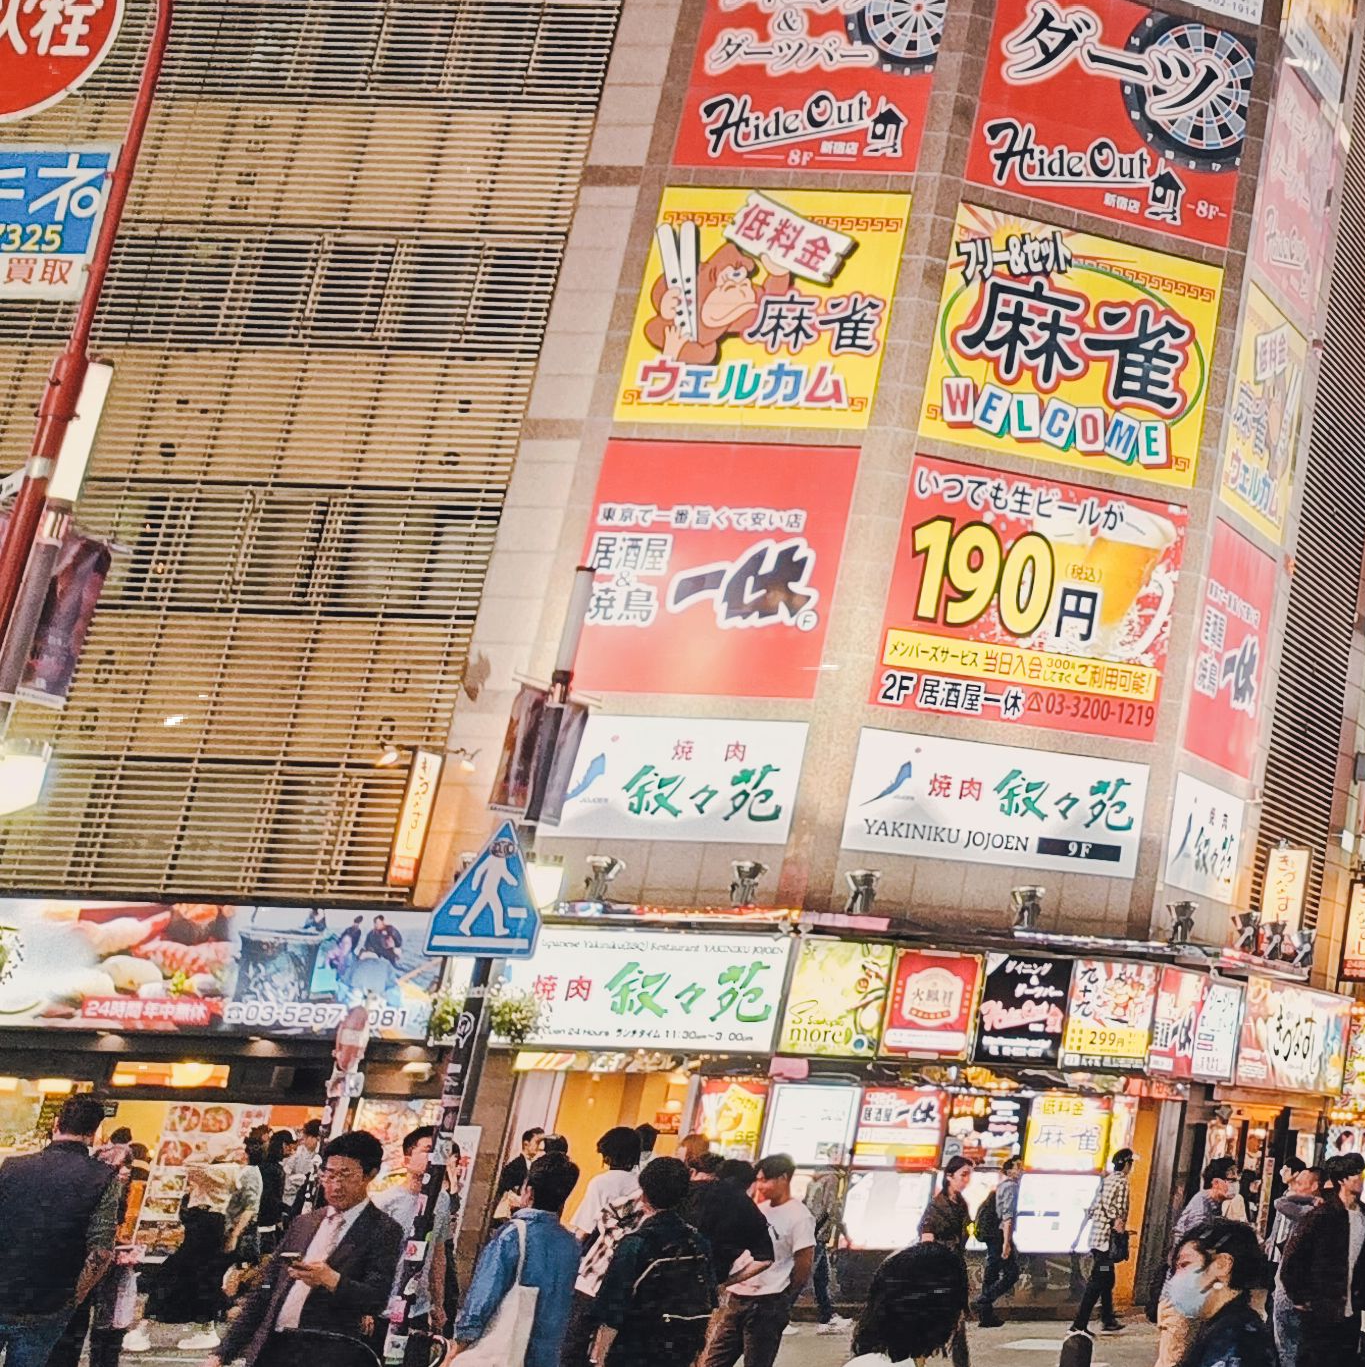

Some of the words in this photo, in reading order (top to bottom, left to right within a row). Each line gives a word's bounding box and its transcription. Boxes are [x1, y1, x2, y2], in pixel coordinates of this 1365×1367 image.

[775, 9, 801, 32] &
[709, 33, 873, 70] ダーツバー
[1006, 1, 1223, 116] ダーツ
[1103, 192, 1141, 213] 新宿店
[735, 203, 832, 272] 低料金
[956, 231, 1073, 287] フリー&セット
[6, 258, 73, 286] 買取
[745, 292, 885, 353] 麻雀
[959, 278, 1188, 412] 麻雀
[639, 358, 844, 406] ウェルカム
[943, 381, 1164, 461] WELCOME
[601, 506, 805, 530] 東京で一番旨くて安い店
[915, 468, 1125, 531] いつでも生ビールが
[594, 535, 669, 572] 居酒屋
[911, 515, 1056, 638] 190
[673, 543, 813, 622] 一休
[1054, 586, 1098, 642] 円
[888, 640, 979, 668] メンバーズサービス
[983, 651, 1044, 680] 当日入会
[881, 673, 915, 702] 2F
[919, 677, 1023, 717] 居酒屋一休
[1045, 693, 1155, 728] 03-3200-1219
[672, 739, 747, 763] 焼肉
[622, 764, 781, 822] 叙々苑
[928, 773, 983, 802] 焼肉
[993, 768, 1134, 832] 叙々苑
[863, 818, 960, 844] YAKINIKU
[964, 830, 1029, 852] JOJOEN
[1067, 841, 1092, 858] 9F
[84, 1000, 142, 1021] 24時間
[532, 974, 592, 1003] 焼肉
[604, 961, 771, 1023] 叙々苑
[1073, 967, 1099, 1018] 九十九
[788, 1026, 844, 1044] more
[1035, 1124, 1100, 1152] 麻雀
